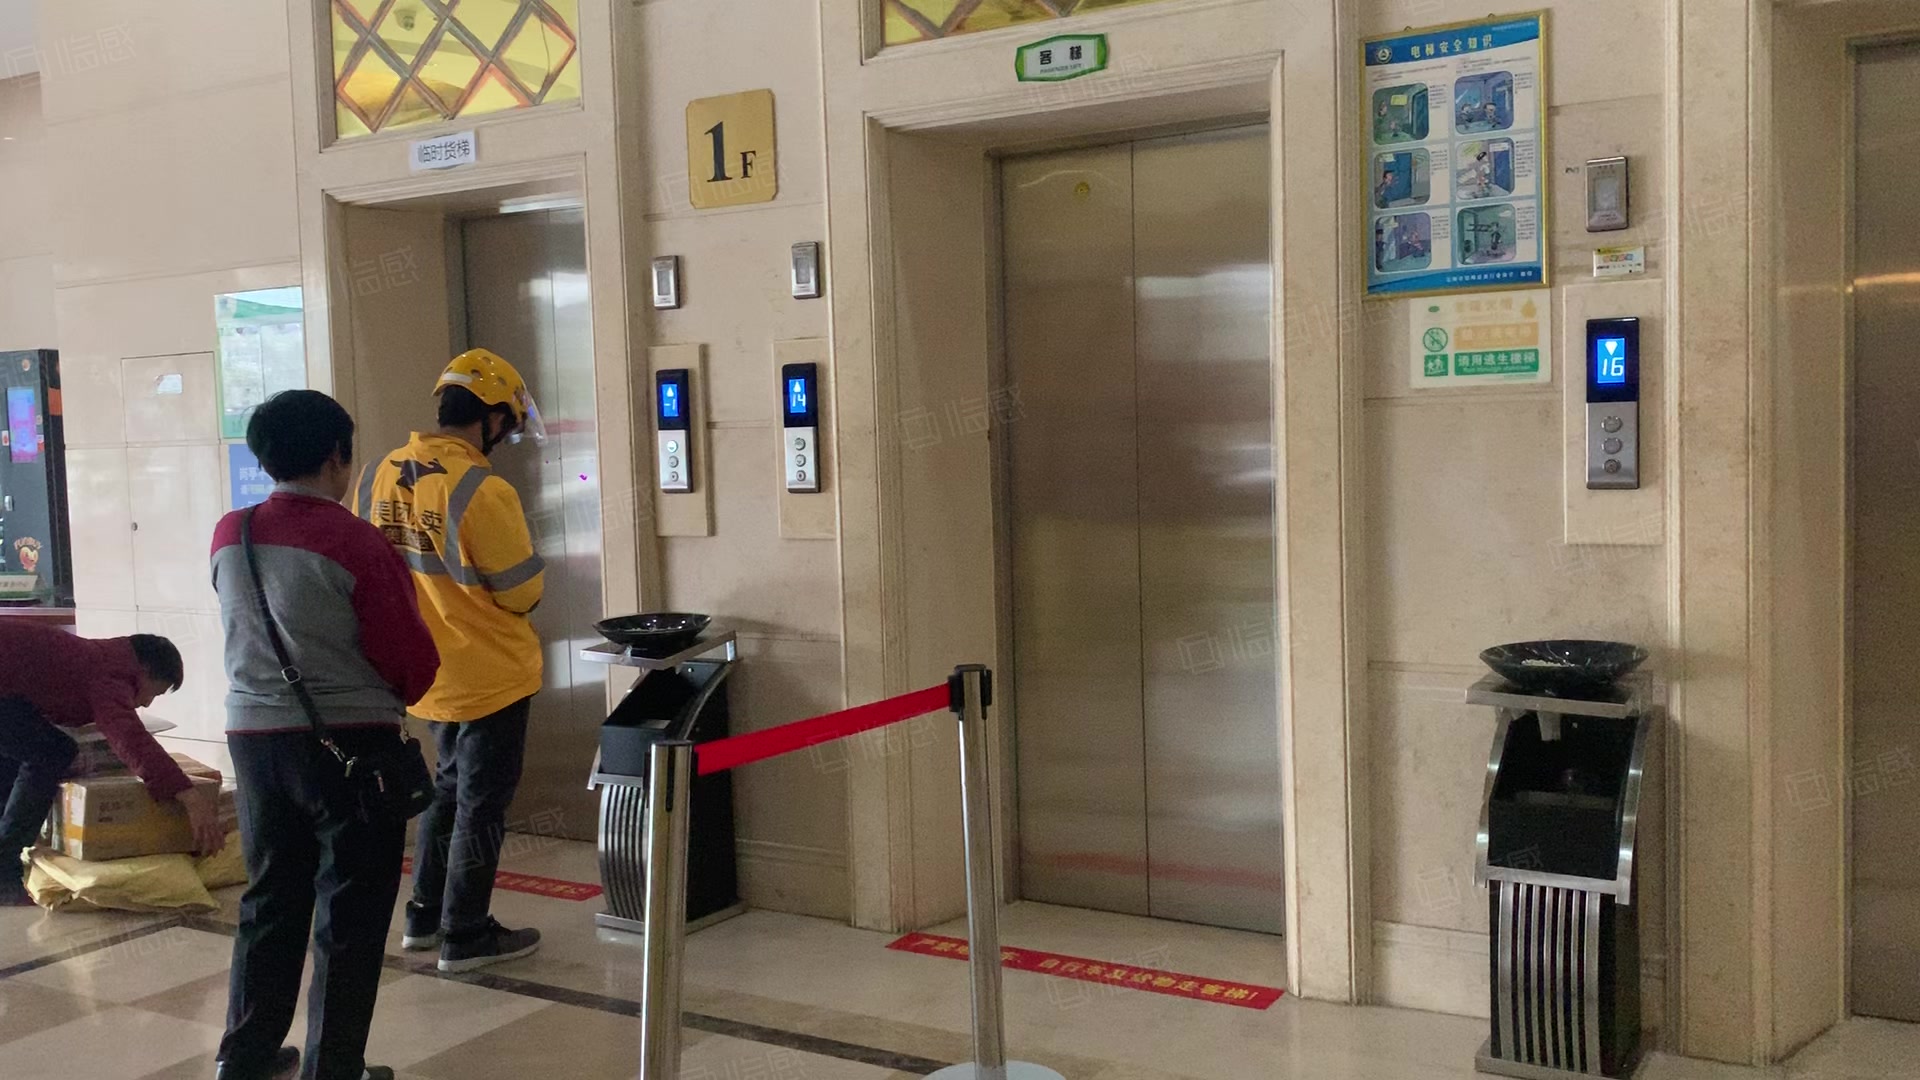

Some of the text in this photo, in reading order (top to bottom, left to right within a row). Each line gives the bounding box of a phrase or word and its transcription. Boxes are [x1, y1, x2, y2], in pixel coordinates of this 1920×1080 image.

[1040, 45, 1082, 65] 客梯
[1410, 34, 1493, 59] 电梯安全知识
[418, 139, 470, 163] 临时货梯
[703, 121, 757, 183] 1F
[1602, 357, 1624, 376] 16
[664, 399, 676, 410] -1
[792, 394, 806, 407] 14
[376, 500, 442, 535] 美团卖
